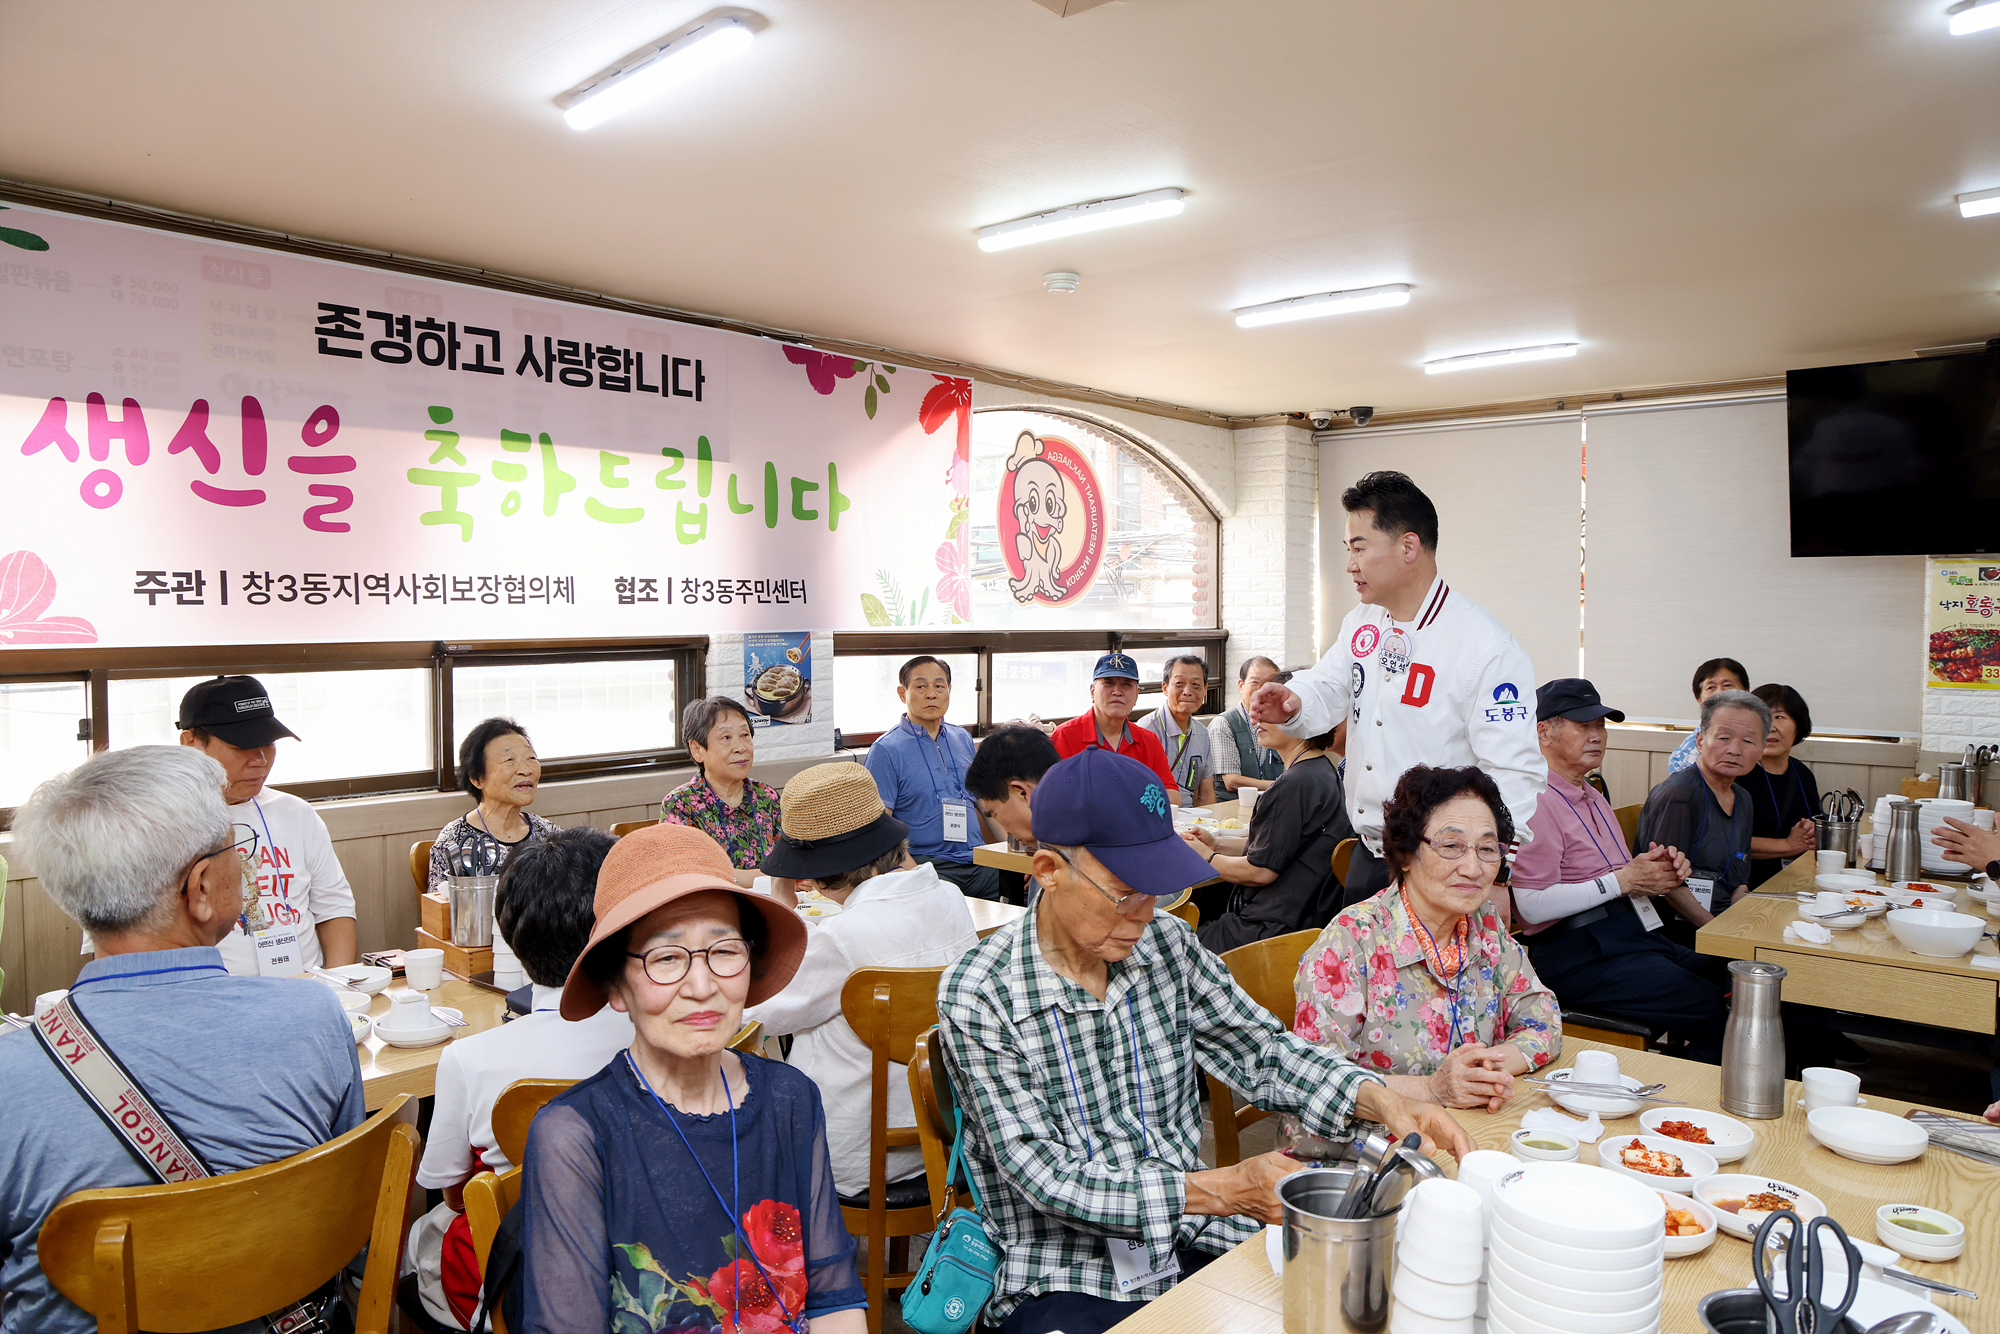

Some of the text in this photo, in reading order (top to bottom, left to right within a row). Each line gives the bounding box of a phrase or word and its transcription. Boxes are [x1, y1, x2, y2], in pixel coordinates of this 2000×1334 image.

[315, 302, 504, 375] 존경하고
[515, 334, 706, 402] 사랑합니다
[20, 391, 850, 545] 생신을 축하드립니다
[134, 570, 206, 606] 주관
[243, 570, 575, 606] 창3동지역사회보장협의체
[615, 576, 659, 605] 협조
[681, 577, 807, 605] 창3동주민센터
[1939, 600, 1963, 611] 낙지
[1401, 662, 1436, 709] D
[1485, 706, 1529, 723] 도봉구
